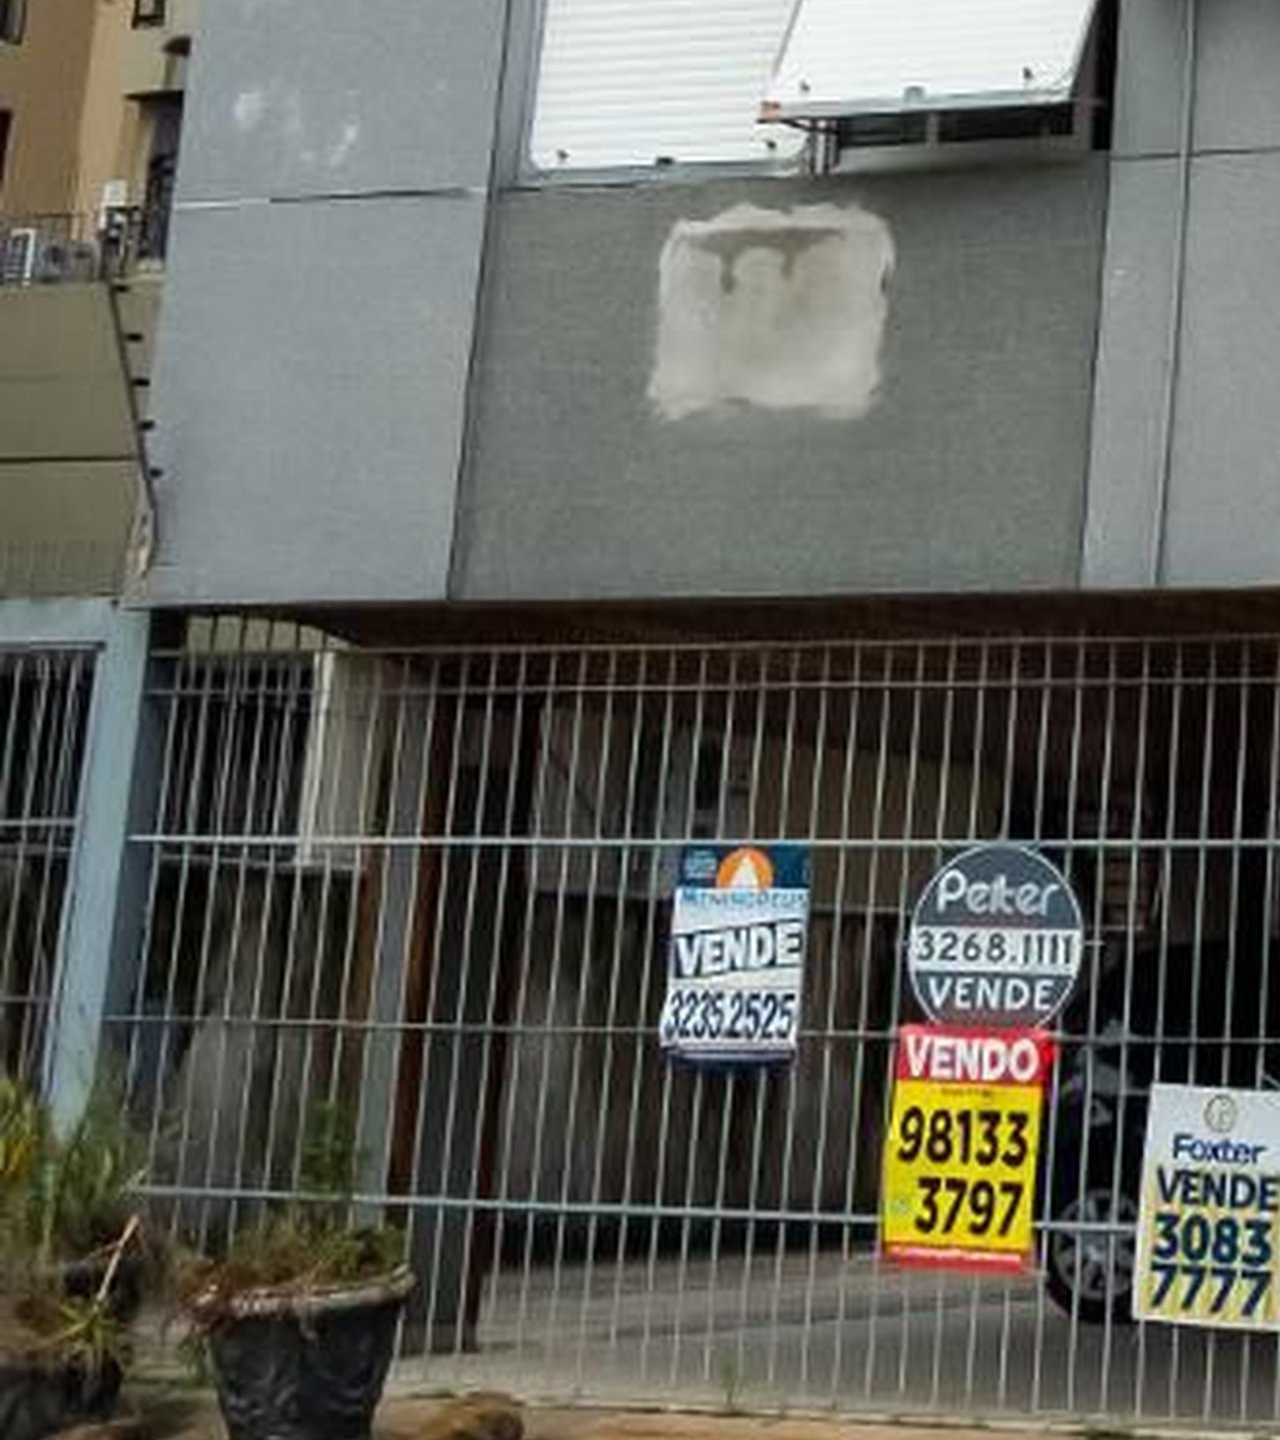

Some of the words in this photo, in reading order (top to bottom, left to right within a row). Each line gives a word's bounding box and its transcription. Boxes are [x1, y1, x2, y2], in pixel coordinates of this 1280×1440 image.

[675, 922, 803, 977] VENDE
[916, 929, 1074, 965] 3268.1111
[928, 976, 1055, 1012] VENDE
[905, 1034, 1040, 1083] VENDO
[897, 1105, 1029, 1167] 98133
[1171, 1132, 1267, 1165] Foxter
[914, 1176, 1024, 1238] 3797
[1151, 1212, 1273, 1267] 3083
[1149, 1262, 1273, 1317] 7777
